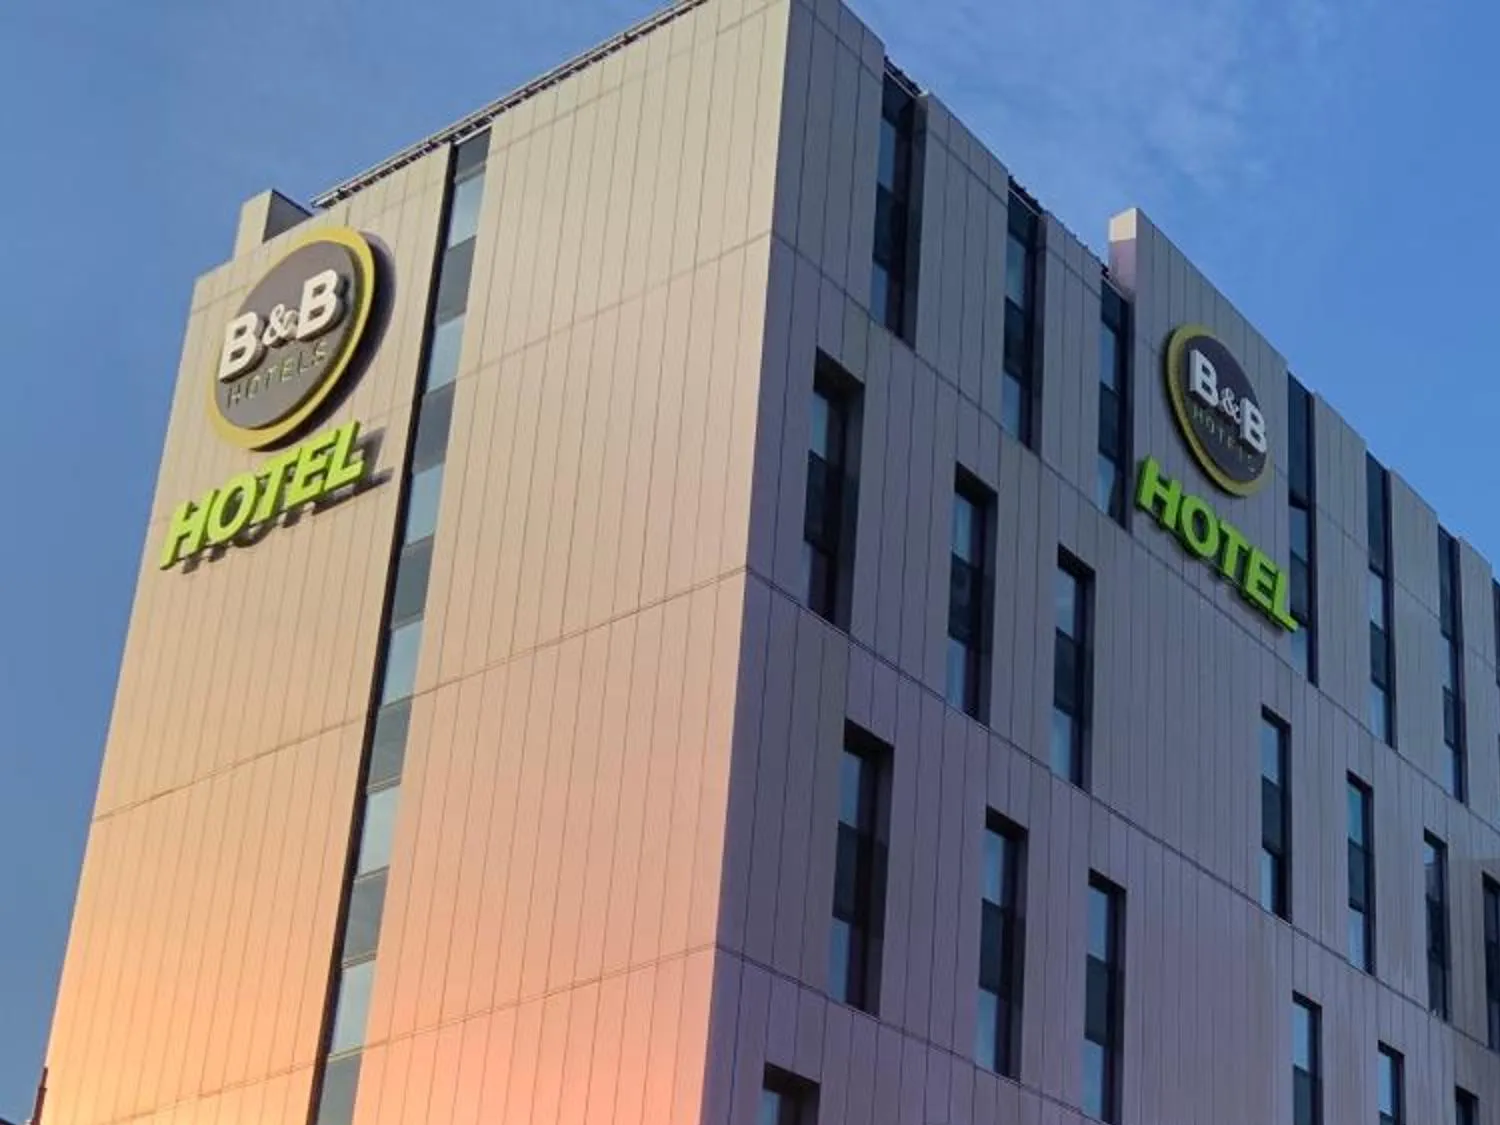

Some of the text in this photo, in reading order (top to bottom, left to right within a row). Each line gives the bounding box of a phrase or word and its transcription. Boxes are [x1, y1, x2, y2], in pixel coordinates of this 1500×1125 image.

[219, 269, 341, 381] B&B
[225, 341, 329, 408] HOTELS
[1189, 350, 1267, 453] B&B
[160, 420, 366, 570] HOTEL
[1136, 455, 1298, 633] HOTEL
